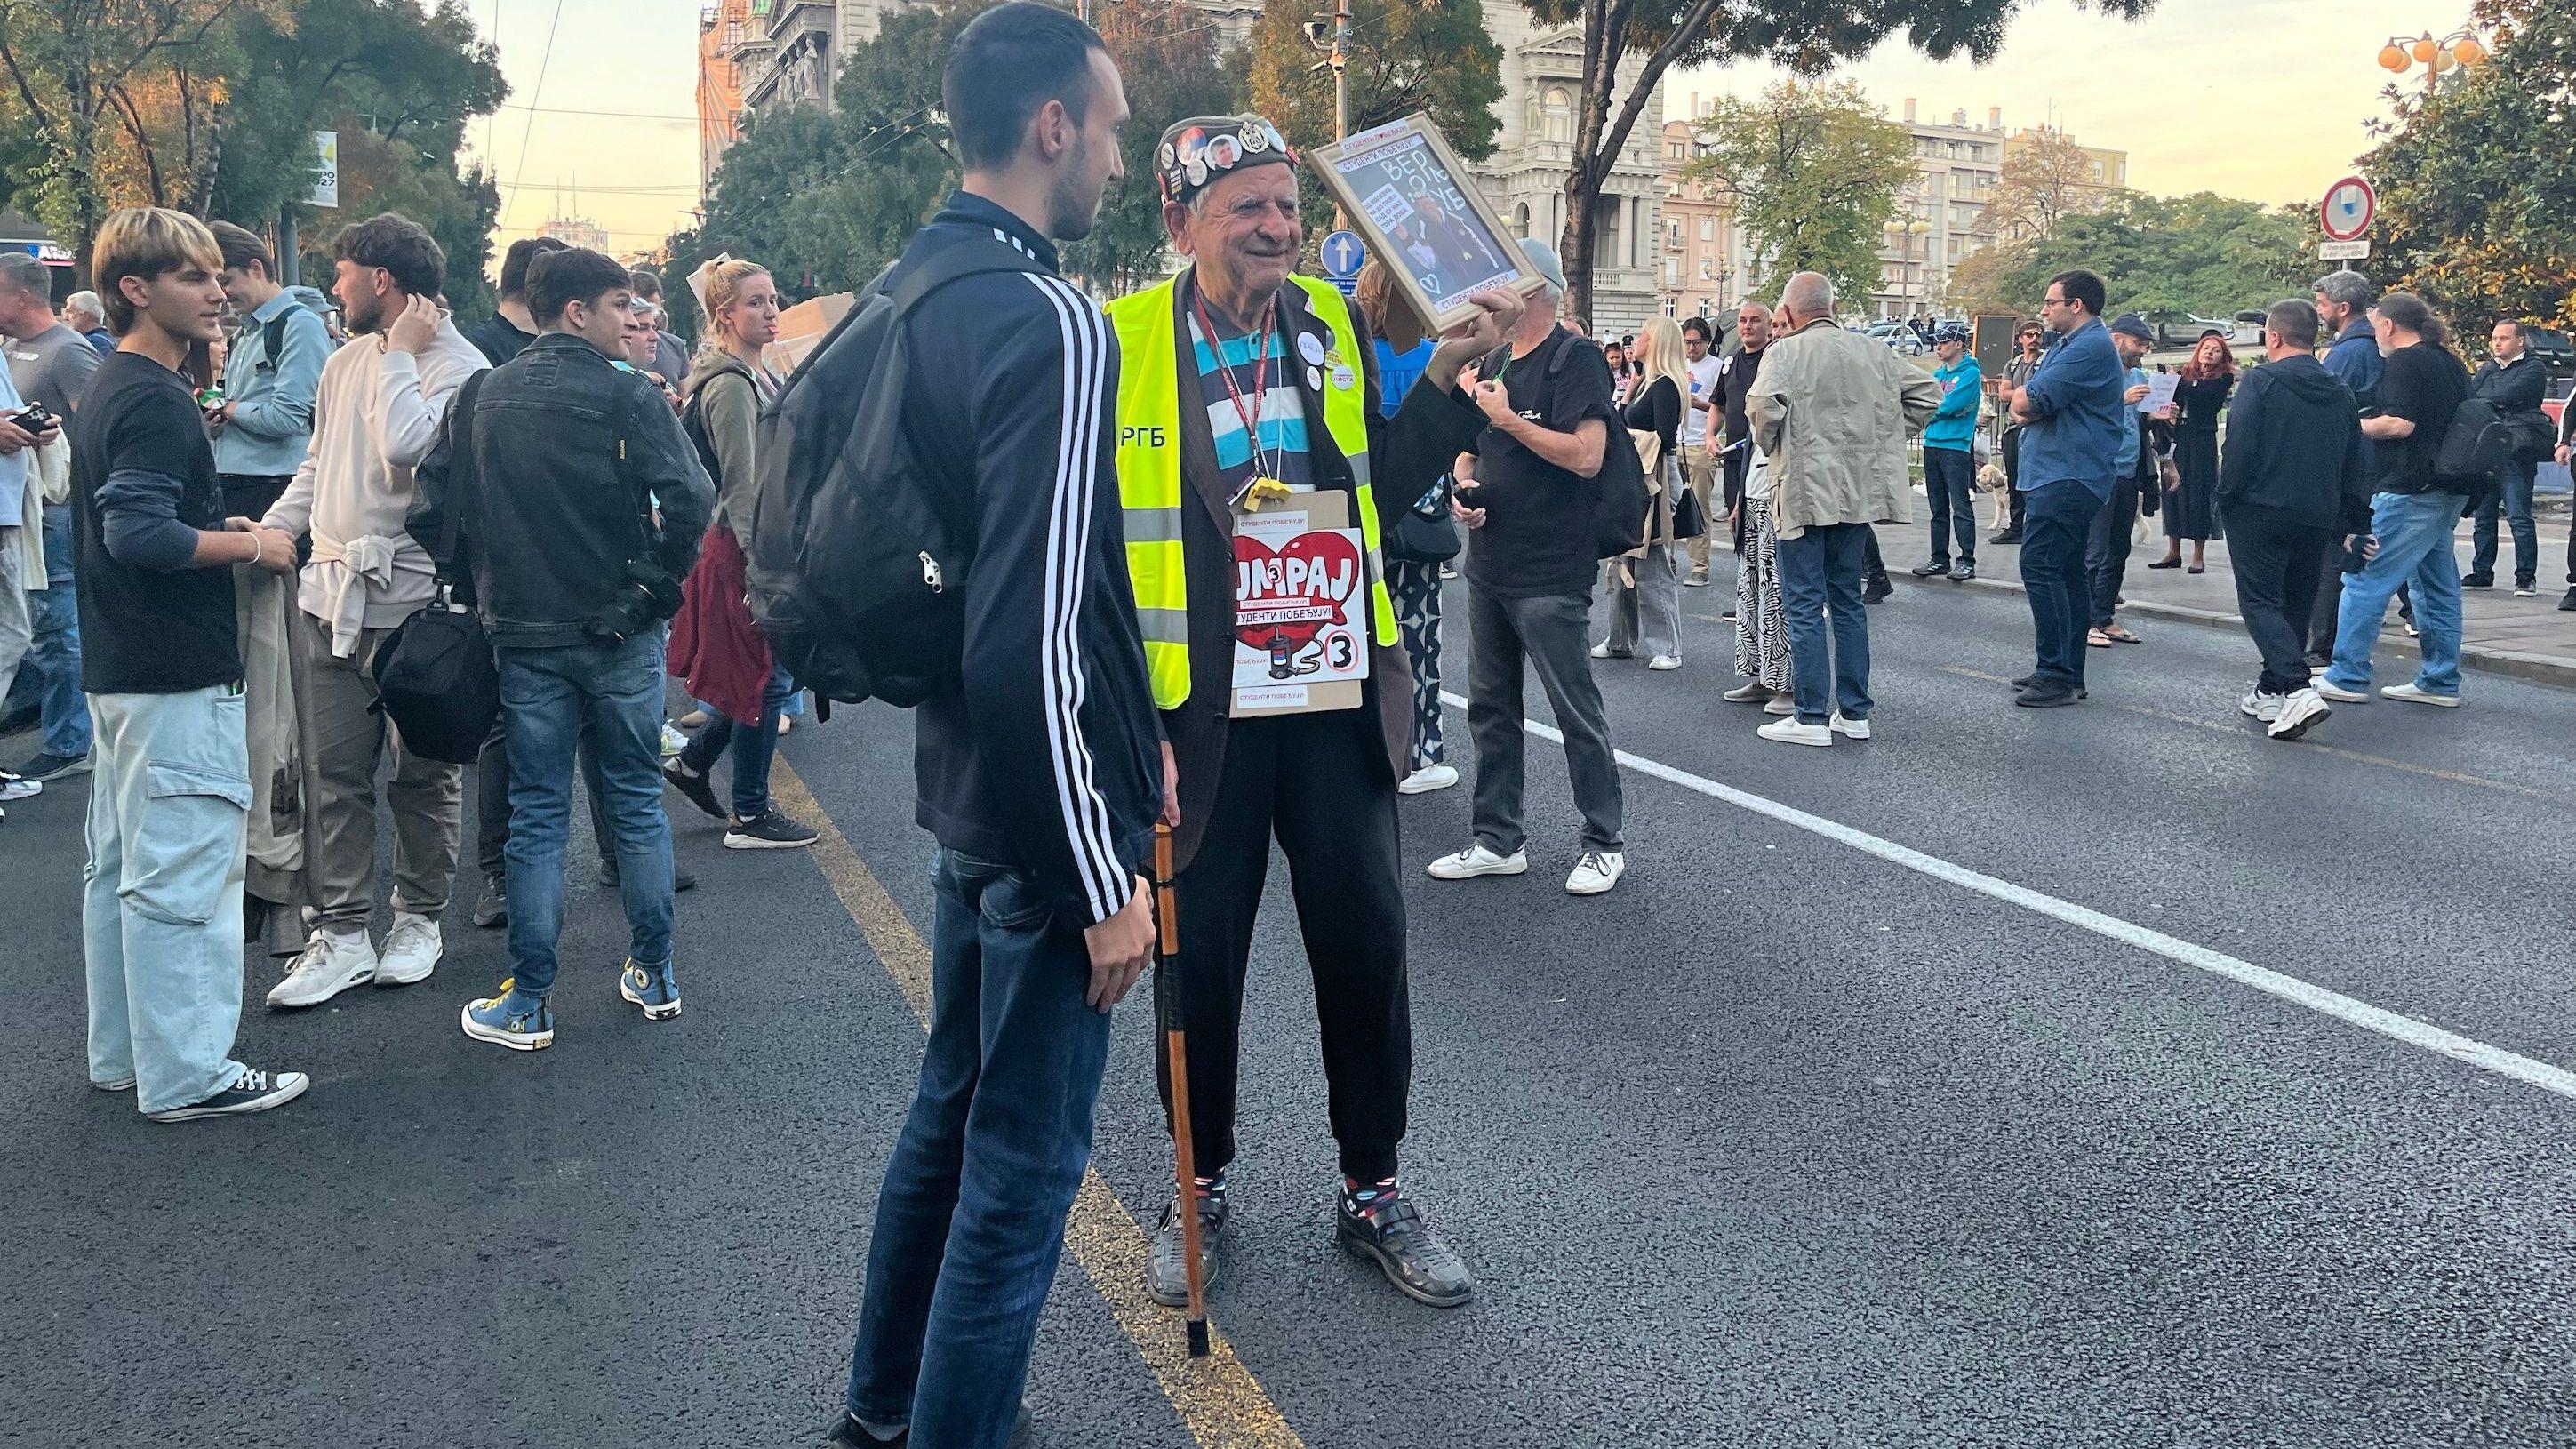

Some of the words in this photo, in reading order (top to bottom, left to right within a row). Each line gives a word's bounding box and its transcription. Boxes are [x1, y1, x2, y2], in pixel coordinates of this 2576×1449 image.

[1344, 152, 1377, 170] СТУДЕНТИ
[1121, 427, 1165, 447] РГБ
[1269, 567, 1278, 581] 3
[1237, 612, 1276, 624] ТУДЕНТИ
[1280, 608, 1331, 620] ПОБЕЂУЈУ!
[1331, 635, 1351, 668] 3
